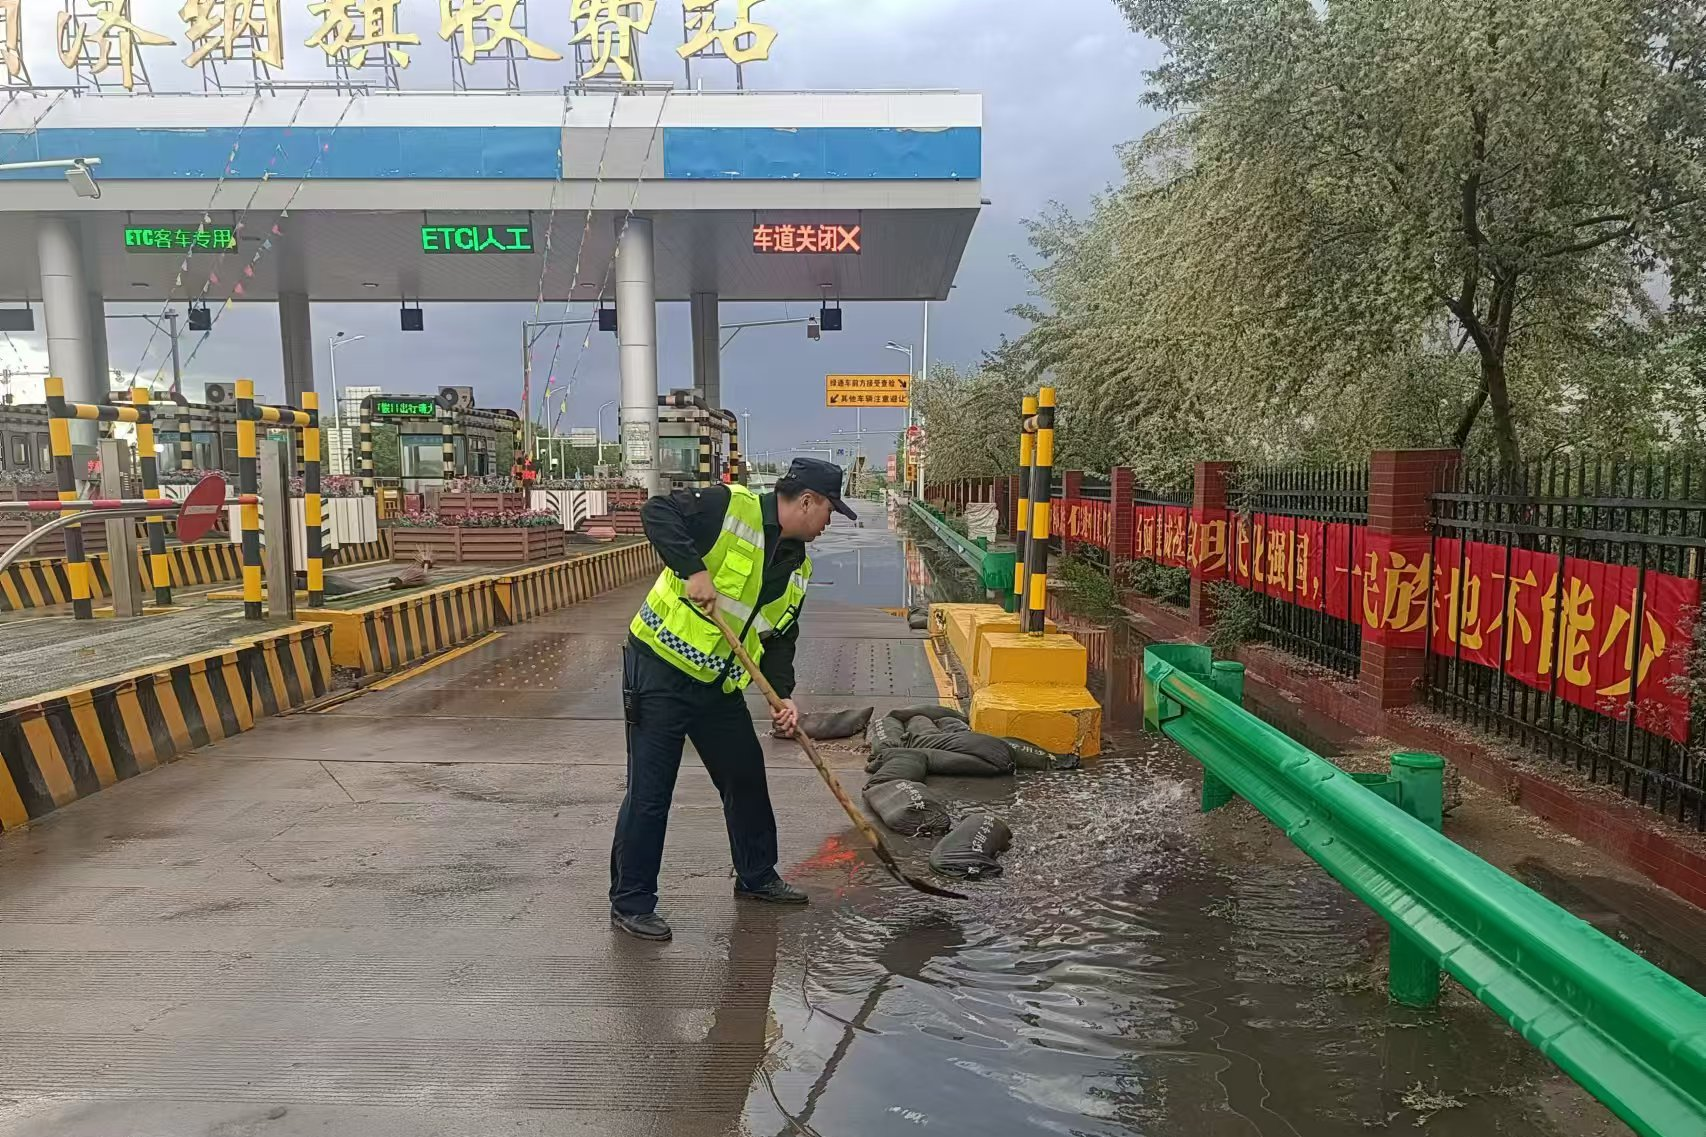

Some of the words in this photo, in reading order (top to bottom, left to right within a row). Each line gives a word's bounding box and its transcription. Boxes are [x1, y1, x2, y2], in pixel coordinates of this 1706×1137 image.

[0, 0, 778, 89] 济纳旗收费站
[125, 229, 231, 248] ETC客车专用
